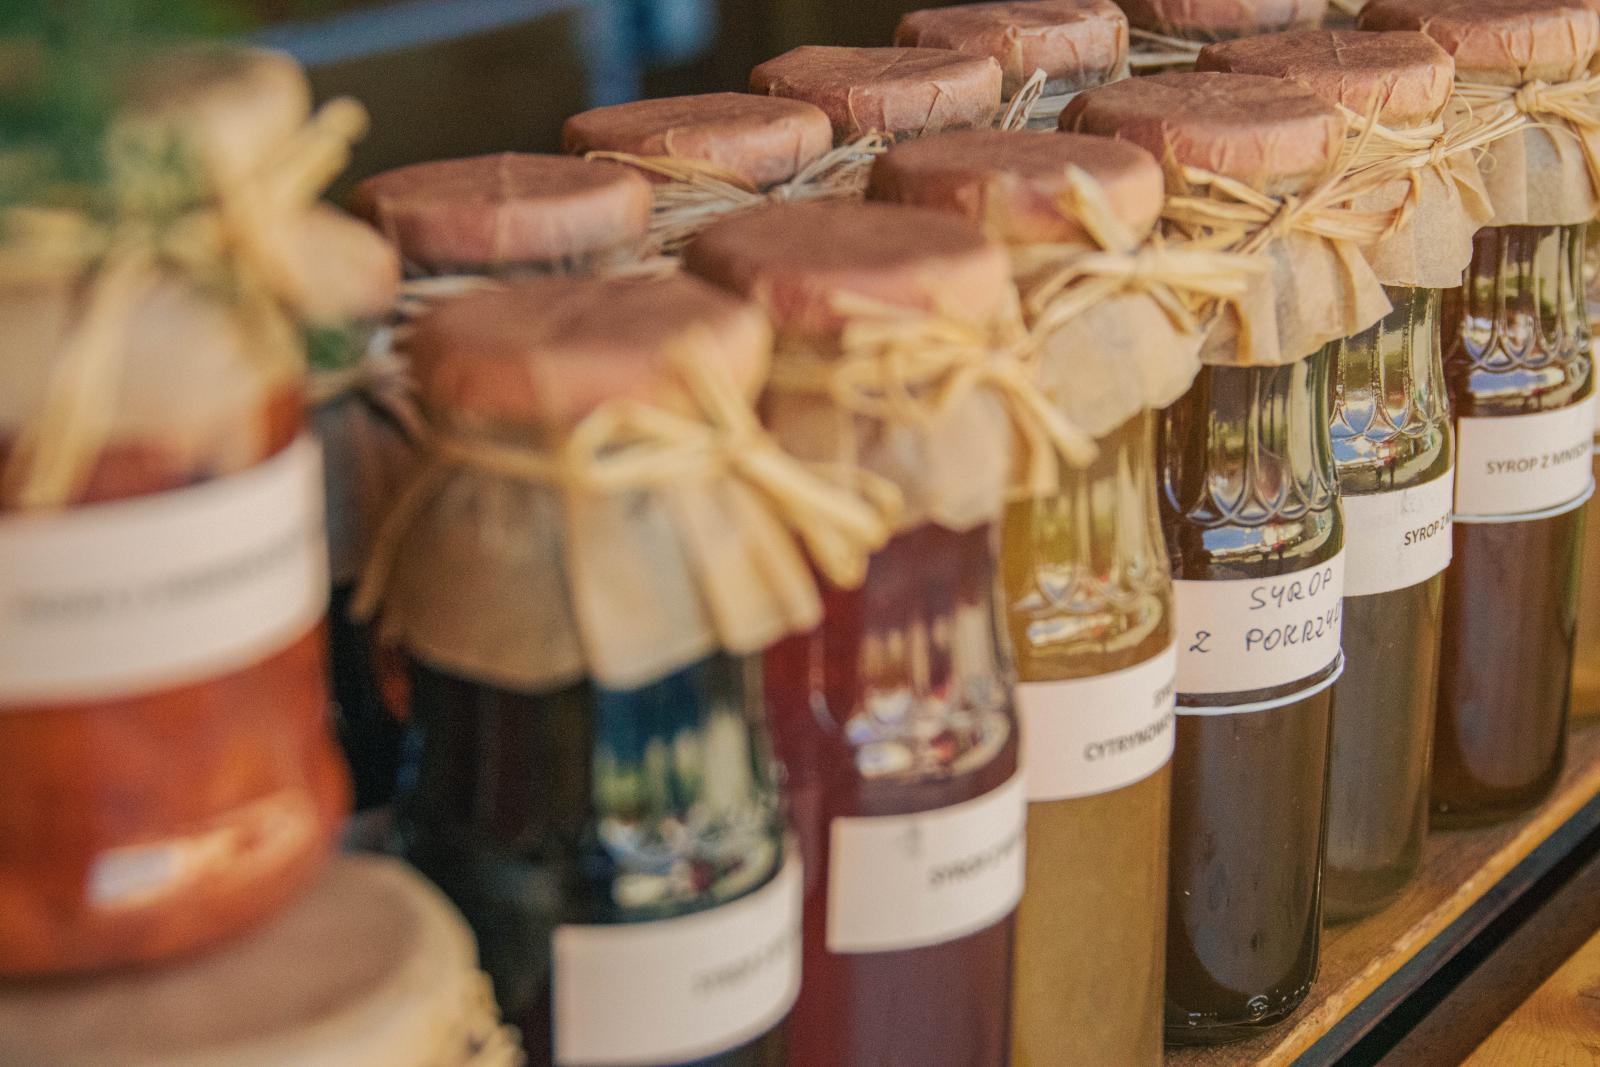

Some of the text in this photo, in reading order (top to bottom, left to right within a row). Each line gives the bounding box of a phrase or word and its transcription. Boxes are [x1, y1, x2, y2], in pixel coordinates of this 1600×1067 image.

[1486, 456, 1538, 475] SYROP
[1540, 454, 1550, 469] Z
[1404, 520, 1440, 546] SYROP
[1440, 515, 1446, 530] Z
[1249, 567, 1332, 610] SYROP
[1083, 711, 1174, 762] CYTRYNOW
